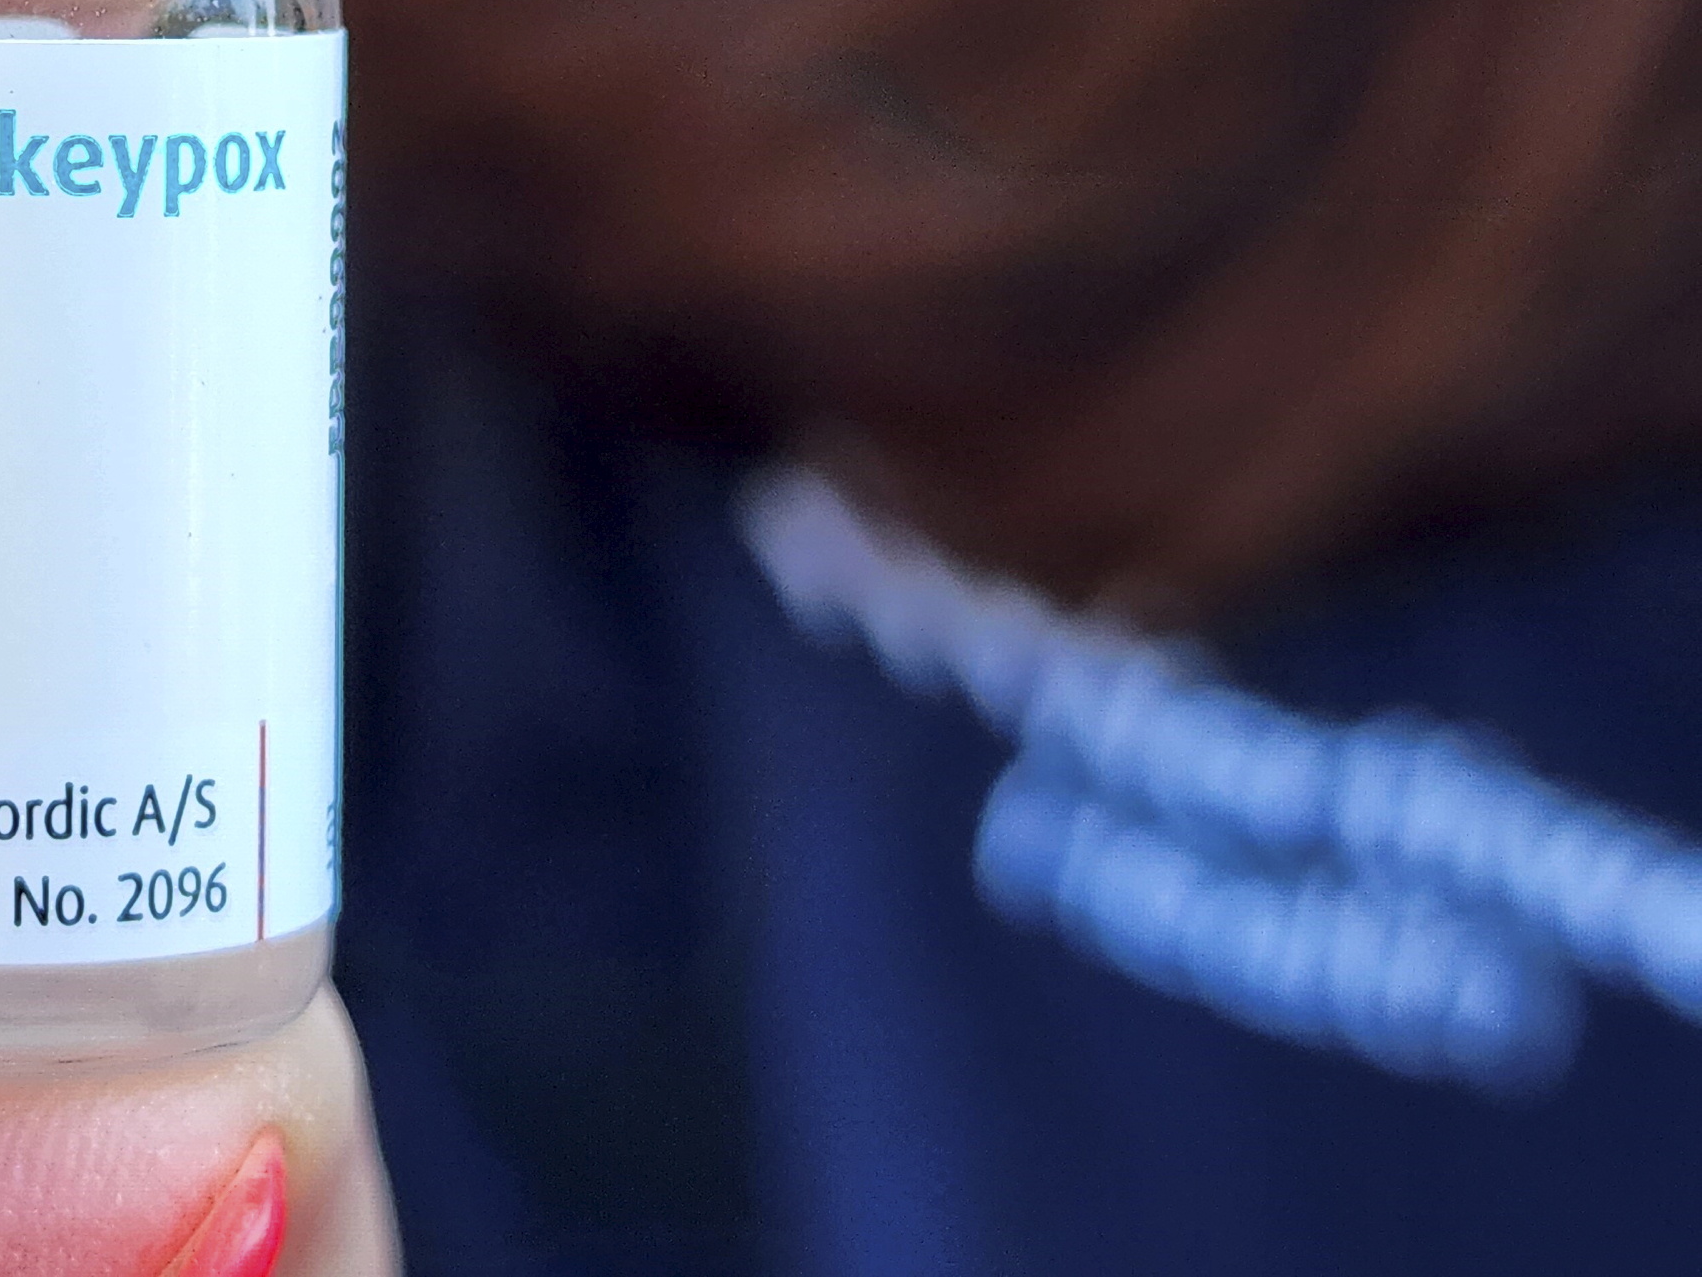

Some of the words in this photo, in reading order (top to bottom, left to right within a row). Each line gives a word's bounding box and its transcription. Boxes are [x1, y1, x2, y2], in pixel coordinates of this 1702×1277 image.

[132, 773, 217, 846] A/S
[13, 875, 98, 927] No.
[116, 861, 228, 922] 2096
